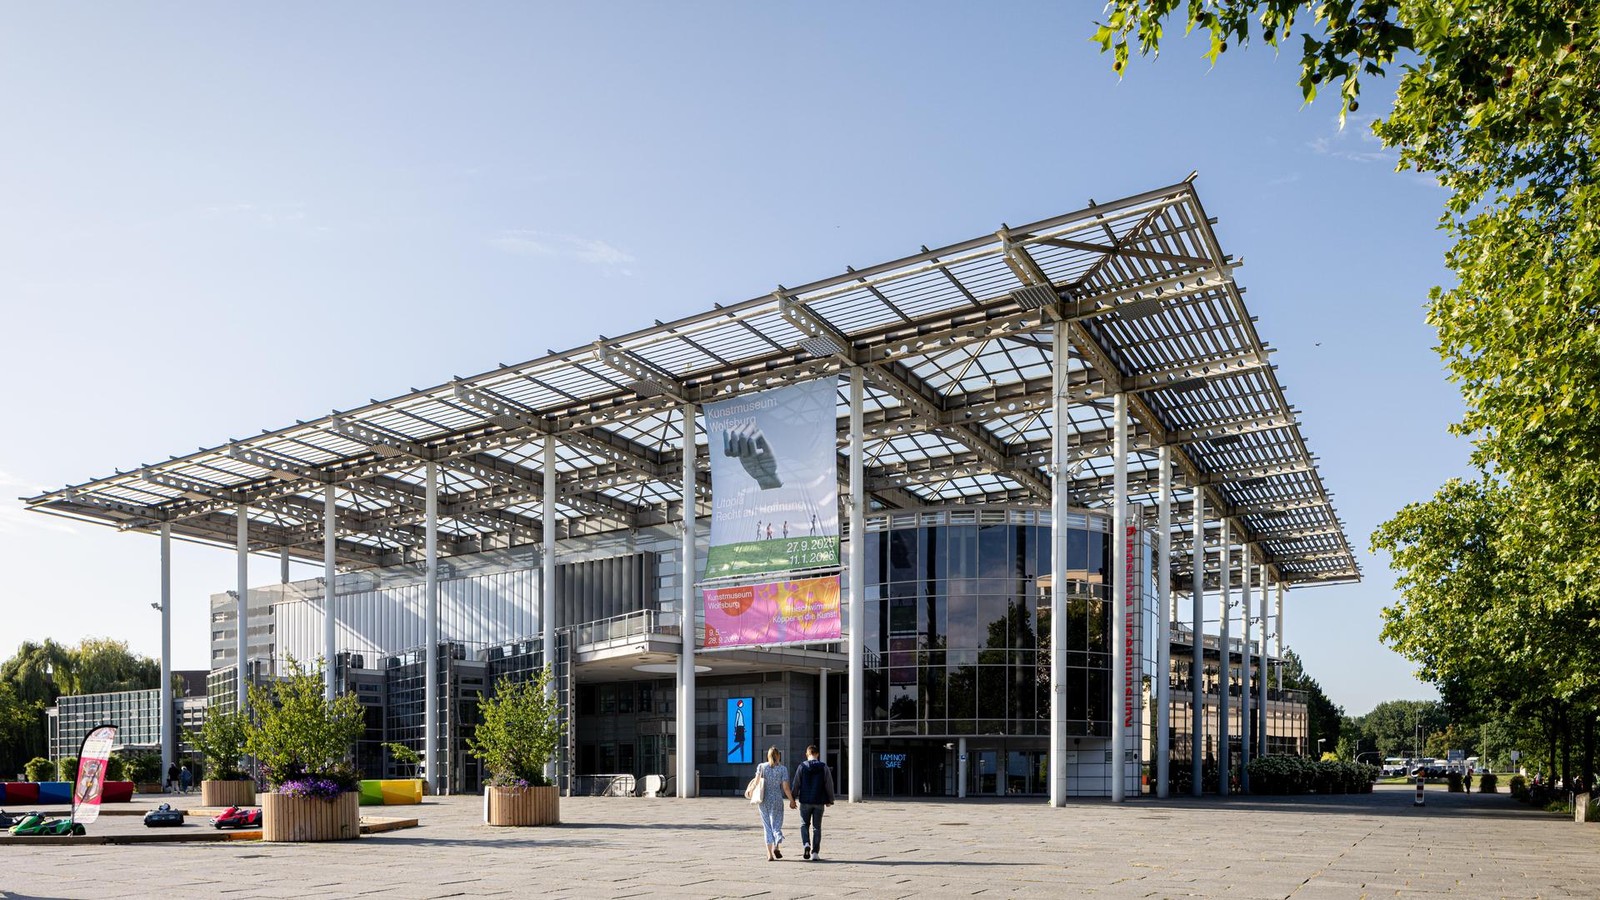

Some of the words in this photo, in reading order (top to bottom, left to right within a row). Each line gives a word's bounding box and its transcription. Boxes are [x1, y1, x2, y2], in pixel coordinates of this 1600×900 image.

[707, 398, 777, 419] Kunstmuseum
[709, 416, 757, 433] Wolfsburg
[707, 590, 753, 601] Kunstmuseum
[708, 600, 740, 610] Wolfsburg
